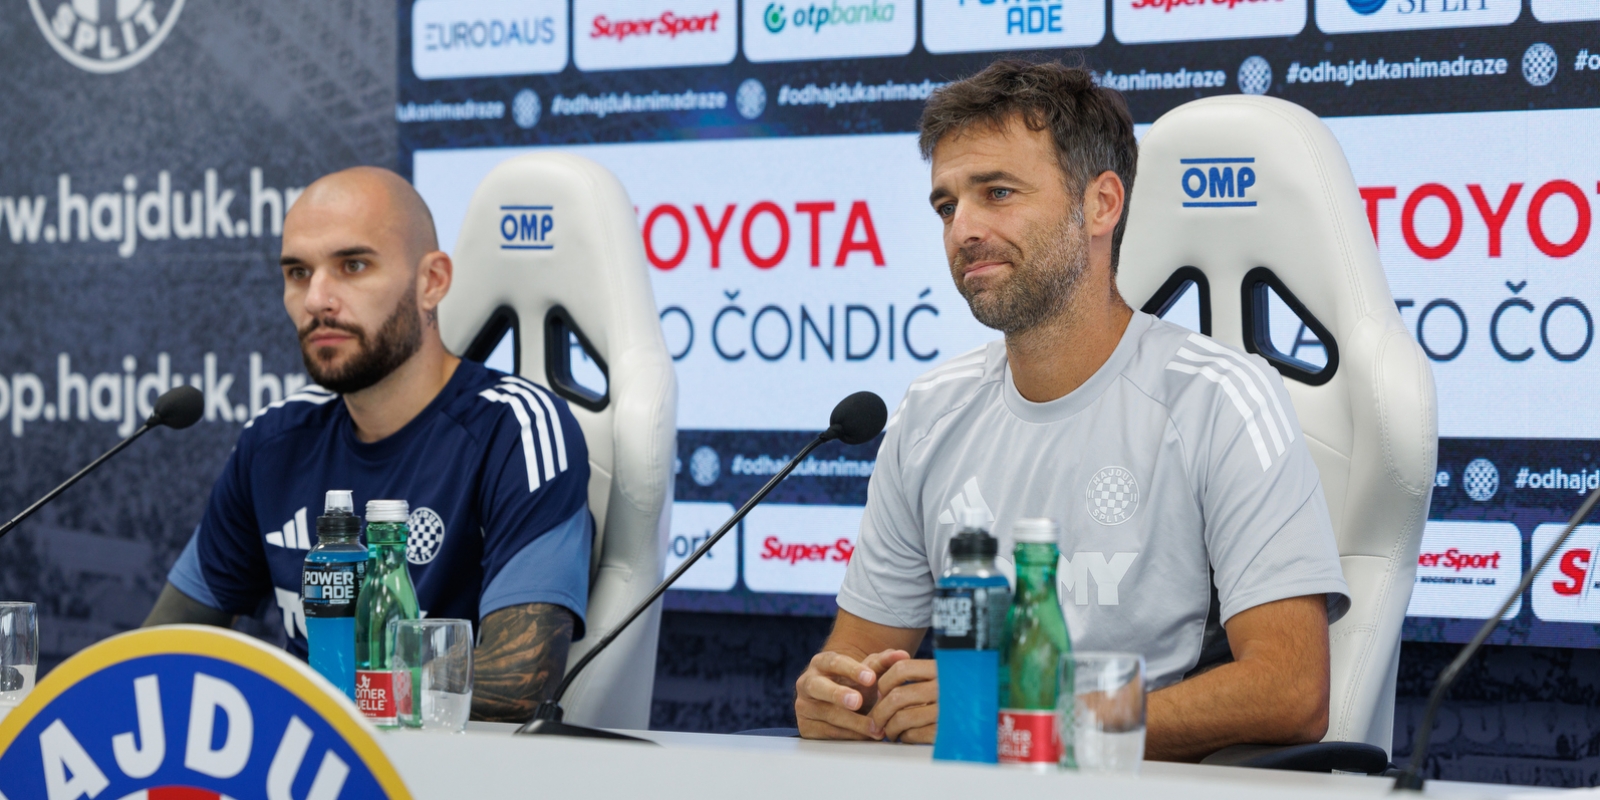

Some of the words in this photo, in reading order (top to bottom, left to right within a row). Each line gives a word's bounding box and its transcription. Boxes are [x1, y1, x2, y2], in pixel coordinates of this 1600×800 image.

[52, 0, 160, 60] SPLIT
[425, 18, 555, 50] EURODAUS
[589, 11, 719, 42] SuperSport
[1006, 5, 1062, 35] ADE
[1286, 56, 1508, 87] #odhajdukanimadraze
[1181, 166, 1256, 199] OMP
[500, 213, 553, 242] OMP
[634, 199, 886, 270] OYOTA
[1358, 179, 1600, 261] TOYO
[711, 288, 940, 362] ČONDIĆ
[1093, 469, 1135, 488] HAJDUK
[1092, 509, 1126, 522] SPLIT
[1417, 547, 1501, 572] erSport
[305, 571, 354, 585] POWER
[322, 585, 354, 599] ADE
[38, 671, 351, 800] AJDU
